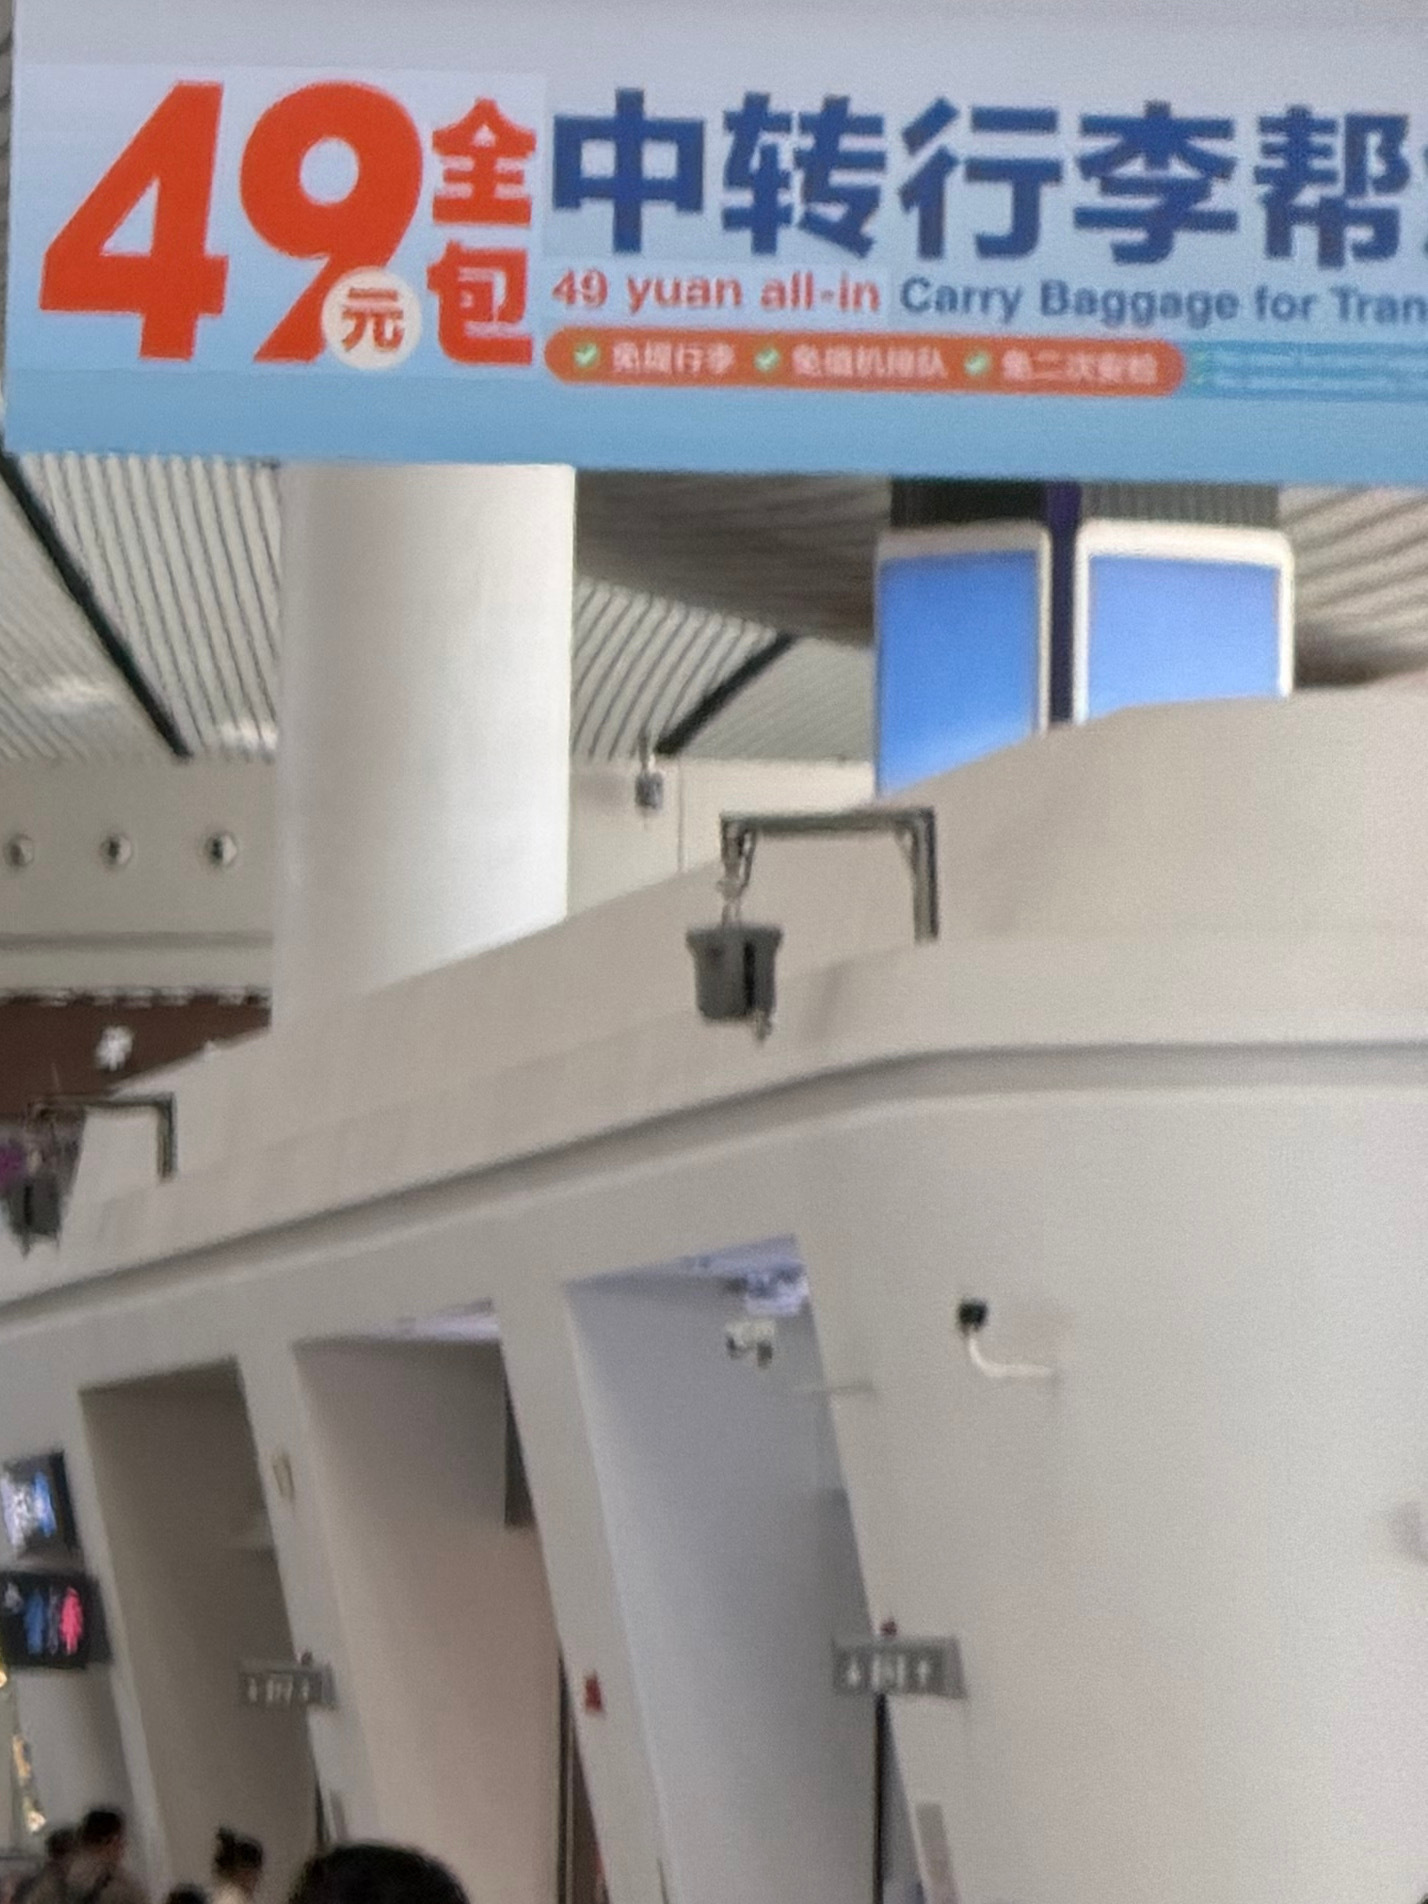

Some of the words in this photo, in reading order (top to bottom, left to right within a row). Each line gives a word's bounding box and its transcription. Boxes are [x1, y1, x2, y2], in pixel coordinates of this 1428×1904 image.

[41, 81, 423, 364] 49
[428, 99, 537, 366] 全包
[549, 86, 1428, 269] 中转行李帮
[341, 286, 404, 353] 元
[552, 268, 609, 306] 49
[626, 272, 745, 314] yuan
[760, 269, 883, 312] all-in
[899, 275, 1022, 324] Carry
[1040, 279, 1239, 329] Baggage
[1254, 283, 1317, 320] for
